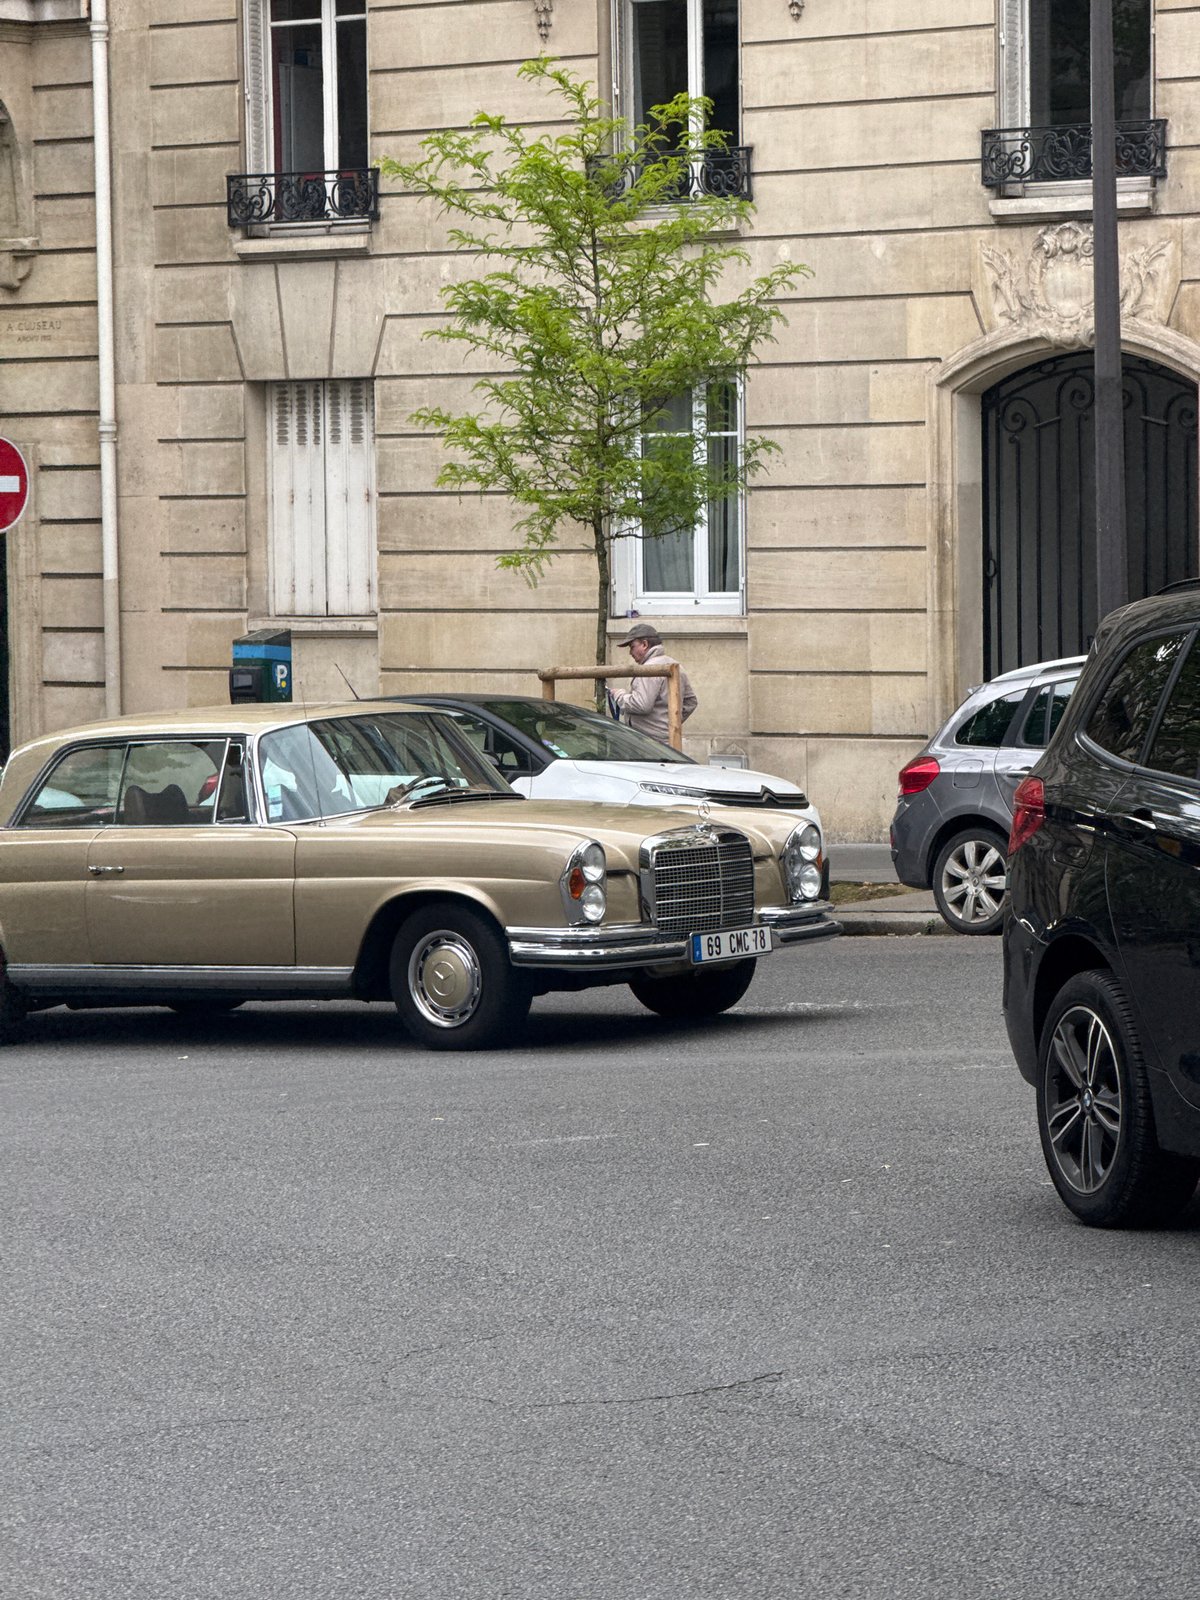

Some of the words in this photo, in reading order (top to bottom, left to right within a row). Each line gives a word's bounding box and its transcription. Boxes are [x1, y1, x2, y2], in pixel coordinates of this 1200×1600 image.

[707, 936, 721, 957] 69
[729, 931, 750, 953] CMC
[752, 929, 766, 951] 78
